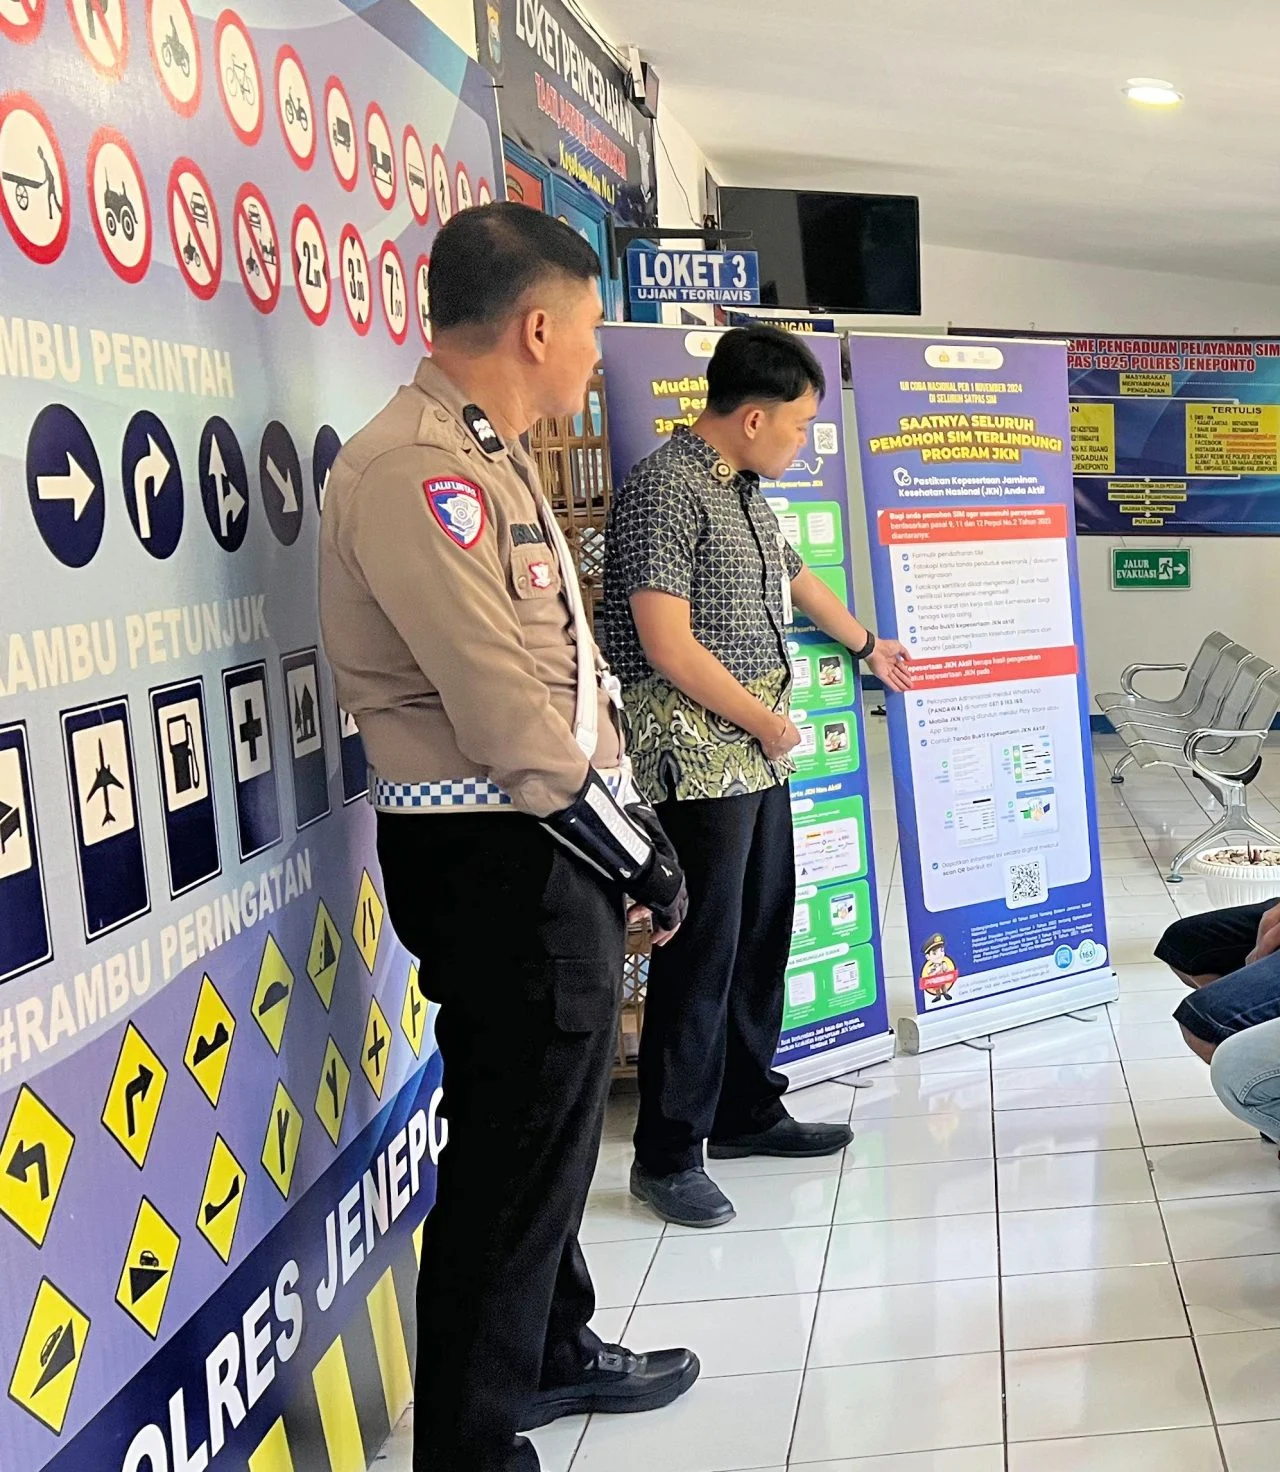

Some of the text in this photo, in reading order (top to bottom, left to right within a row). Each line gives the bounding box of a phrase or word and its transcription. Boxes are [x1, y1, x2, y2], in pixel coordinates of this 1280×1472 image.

[516, 0, 561, 75] LOKET
[562, 27, 635, 147] PENCERAHAN
[639, 252, 747, 287] LOKET 3
[637, 288, 751, 301] UJIAN TEORI/AVIS
[1098, 340, 1177, 354] PENGADUAN
[1180, 342, 1253, 356] PELAYANAN
[1255, 343, 1280, 357] SIM
[90, 329, 234, 398] PERINTAH
[1095, 356, 1129, 369] 1925
[1131, 356, 1180, 371] POLRES
[1184, 357, 1256, 372] JENEPONTO
[651, 377, 708, 395] Mudah
[1211, 406, 1262, 414] TERTULIS
[900, 414, 1034, 431] SAATNYA SELURUH
[870, 431, 944, 452] PEMOHON
[947, 431, 972, 444] SIM
[974, 431, 1062, 452] TERLINDUNGI
[922, 447, 1019, 461] PROGRAM JKN
[913, 475, 1038, 487] Pastikan Kepesertaan Jaminan
[898, 485, 1046, 498] Kesehatan Nasional (JKN) Anda Aktif
[922, 511, 952, 520] pemohon
[952, 510, 966, 518] SIM
[1017, 517, 1036, 525] Tahun
[1123, 559, 1149, 569] JALUR
[1117, 570, 1157, 579] EVAKUASI
[920, 624, 939, 632] Tanda
[0, 594, 271, 696] AMBU PETUNJUK
[908, 664, 943, 674] epesertaan
[943, 662, 957, 670] JKN
[963, 669, 976, 677] JKN
[928, 705, 963, 715] (PANDAWA)
[929, 716, 949, 725] Mobile
[950, 715, 961, 723] JKN
[930, 727, 942, 735] App
[953, 735, 971, 743] Tanda
[160, 848, 313, 981] PERINGATAN
